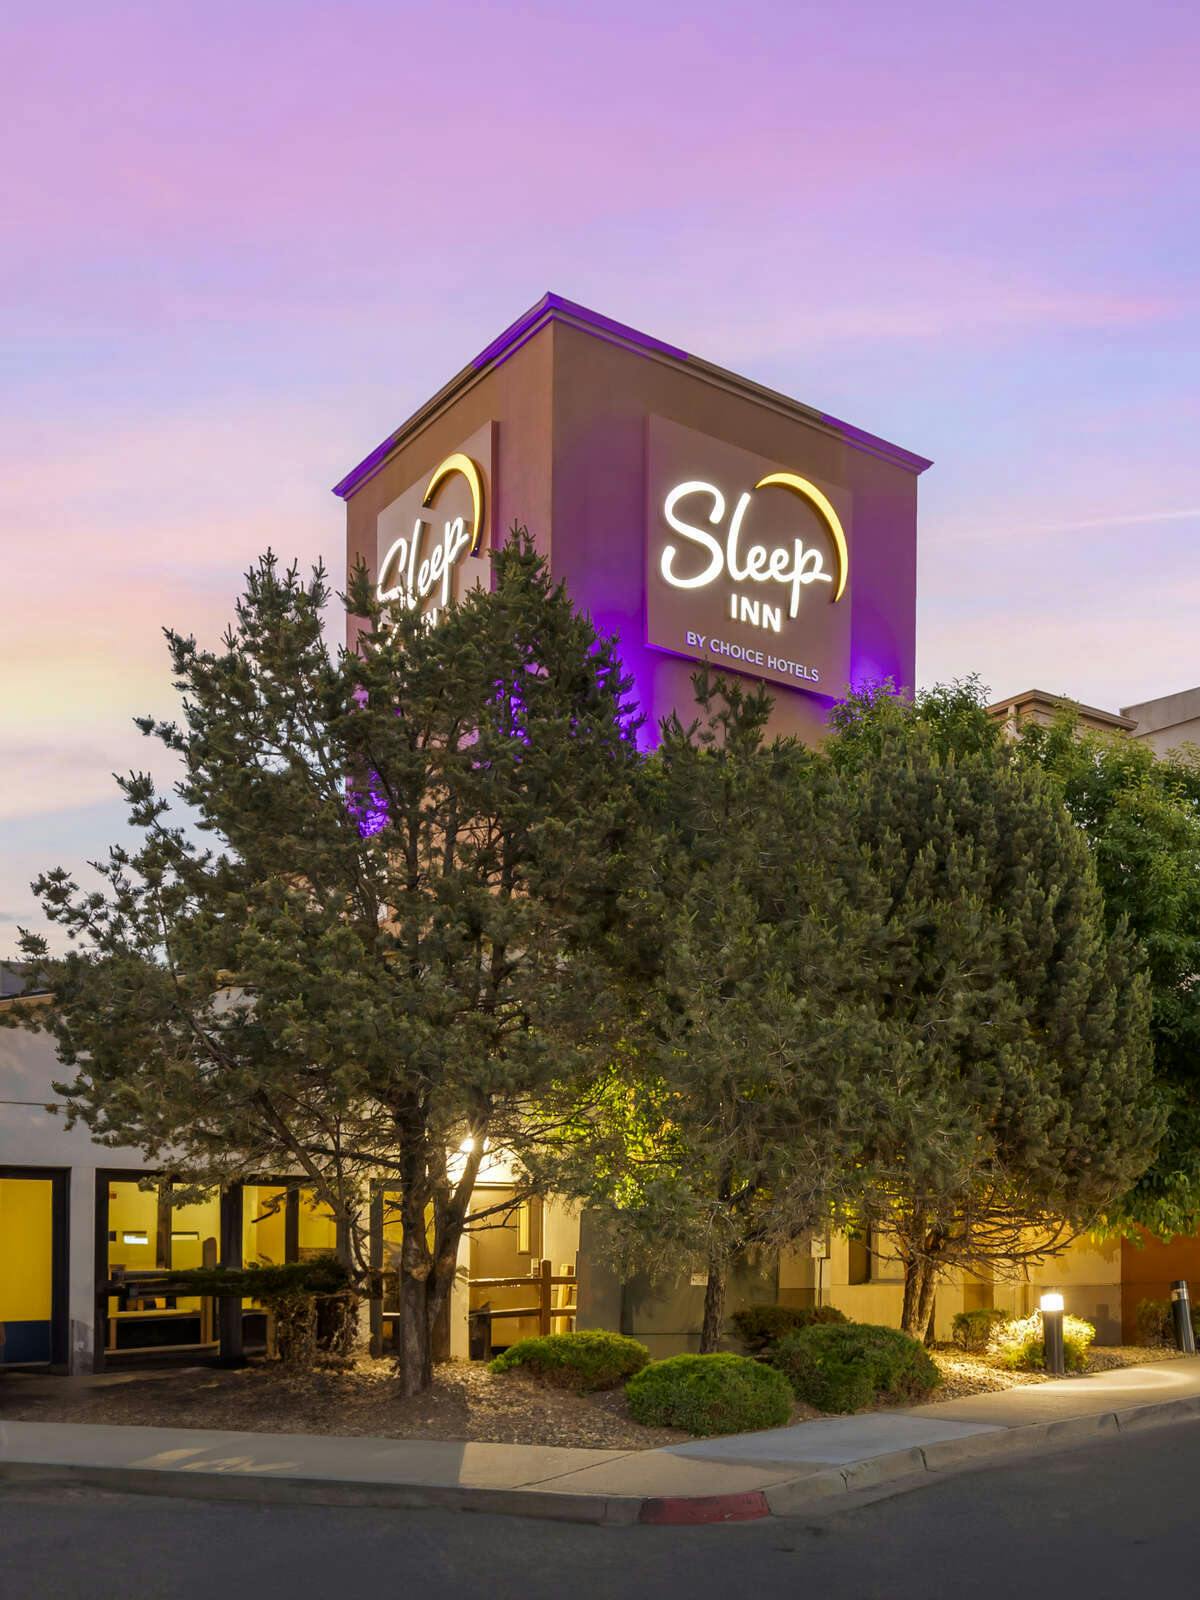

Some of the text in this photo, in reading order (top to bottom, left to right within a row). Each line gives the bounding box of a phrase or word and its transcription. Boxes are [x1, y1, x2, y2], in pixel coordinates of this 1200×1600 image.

[660, 481, 833, 619] Sleep
[731, 593, 782, 633] INN
[686, 631, 820, 682] BY CHOICE HOTELS
